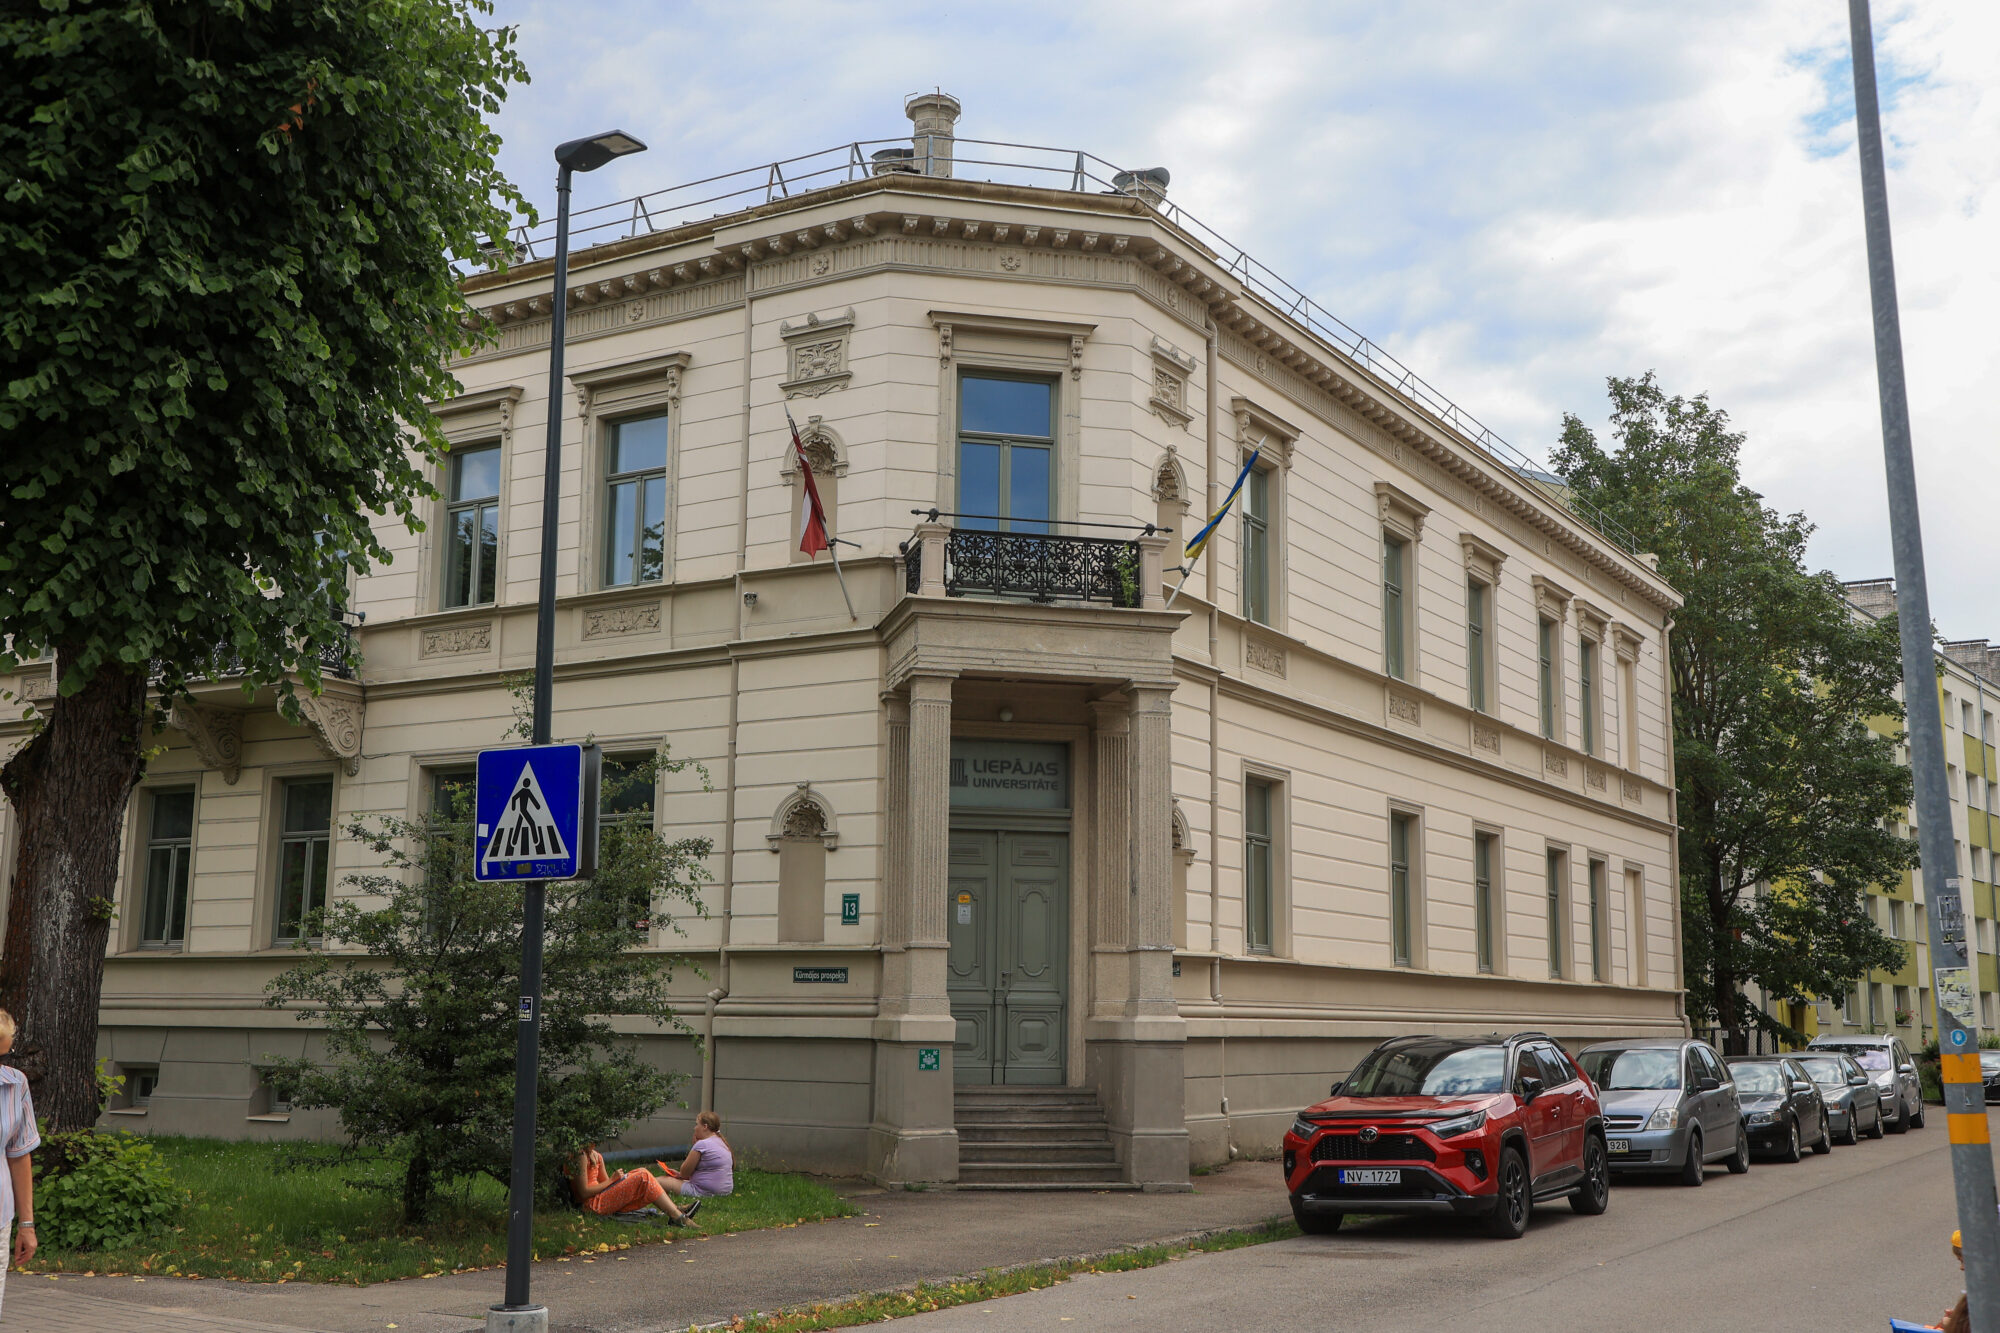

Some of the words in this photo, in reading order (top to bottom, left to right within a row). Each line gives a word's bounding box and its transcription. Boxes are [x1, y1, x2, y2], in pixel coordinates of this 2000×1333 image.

[973, 758, 1059, 776] LIEPĀJAS
[973, 778, 1059, 791] UNIVERSITĀTE
[844, 902, 856, 916] 13
[1610, 1141, 1627, 1150] 928
